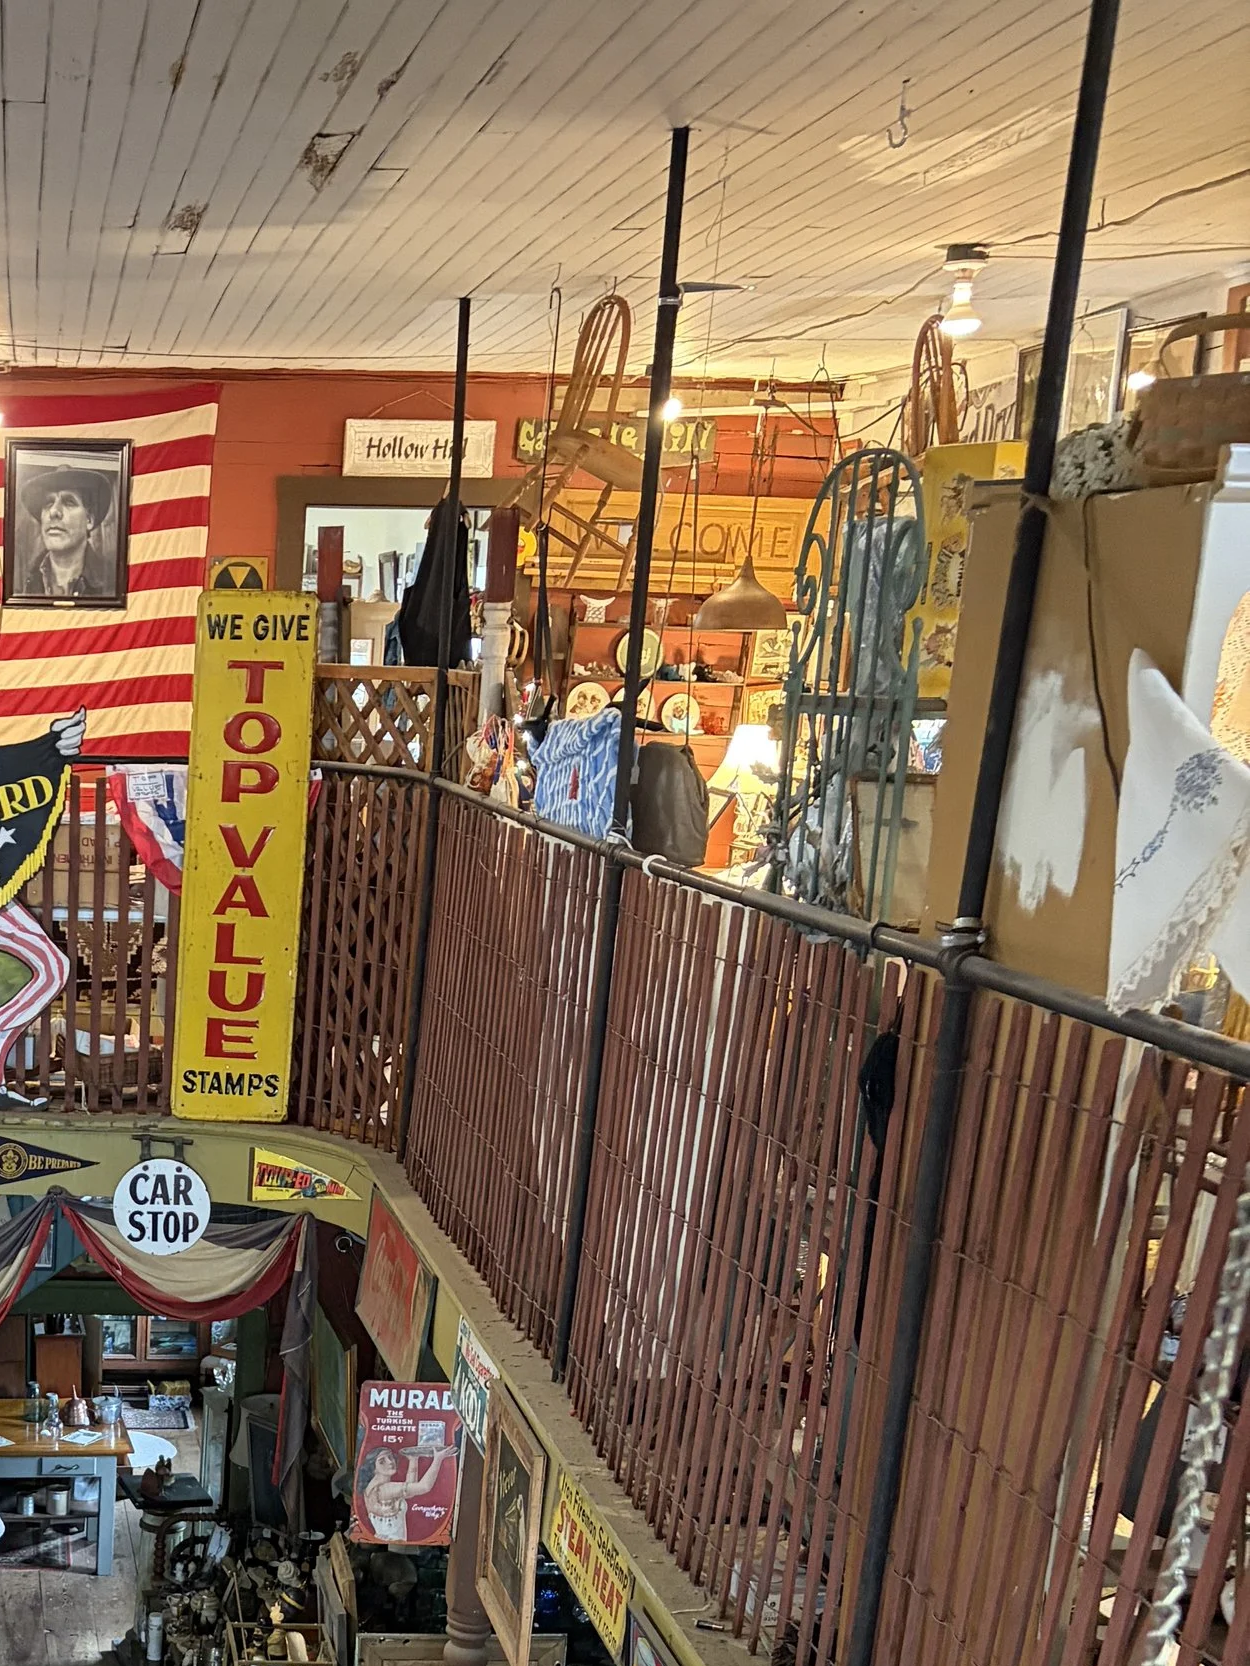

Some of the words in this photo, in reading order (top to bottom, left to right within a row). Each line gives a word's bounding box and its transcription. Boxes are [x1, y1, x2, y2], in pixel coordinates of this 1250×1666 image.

[366, 435, 429, 460] Hollow
[207, 613, 243, 640] WE
[253, 613, 310, 641] GIVE
[221, 660, 284, 803] TOP
[205, 824, 276, 1060] VALUE
[182, 1069, 280, 1098] STAMPS
[28, 1154, 47, 1170] BE
[129, 1172, 194, 1206] CAR
[127, 1210, 199, 1244] STOP
[370, 1388, 454, 1411] MURAD
[459, 1372, 482, 1444] KOOL
[371, 1424, 417, 1432] CIGARETTE
[376, 1417, 413, 1425] TURKISH
[557, 1500, 592, 1575] STEAM
[592, 1555, 623, 1625] HEAT
[587, 1594, 602, 1629] every
[602, 1620, 617, 1650] room
